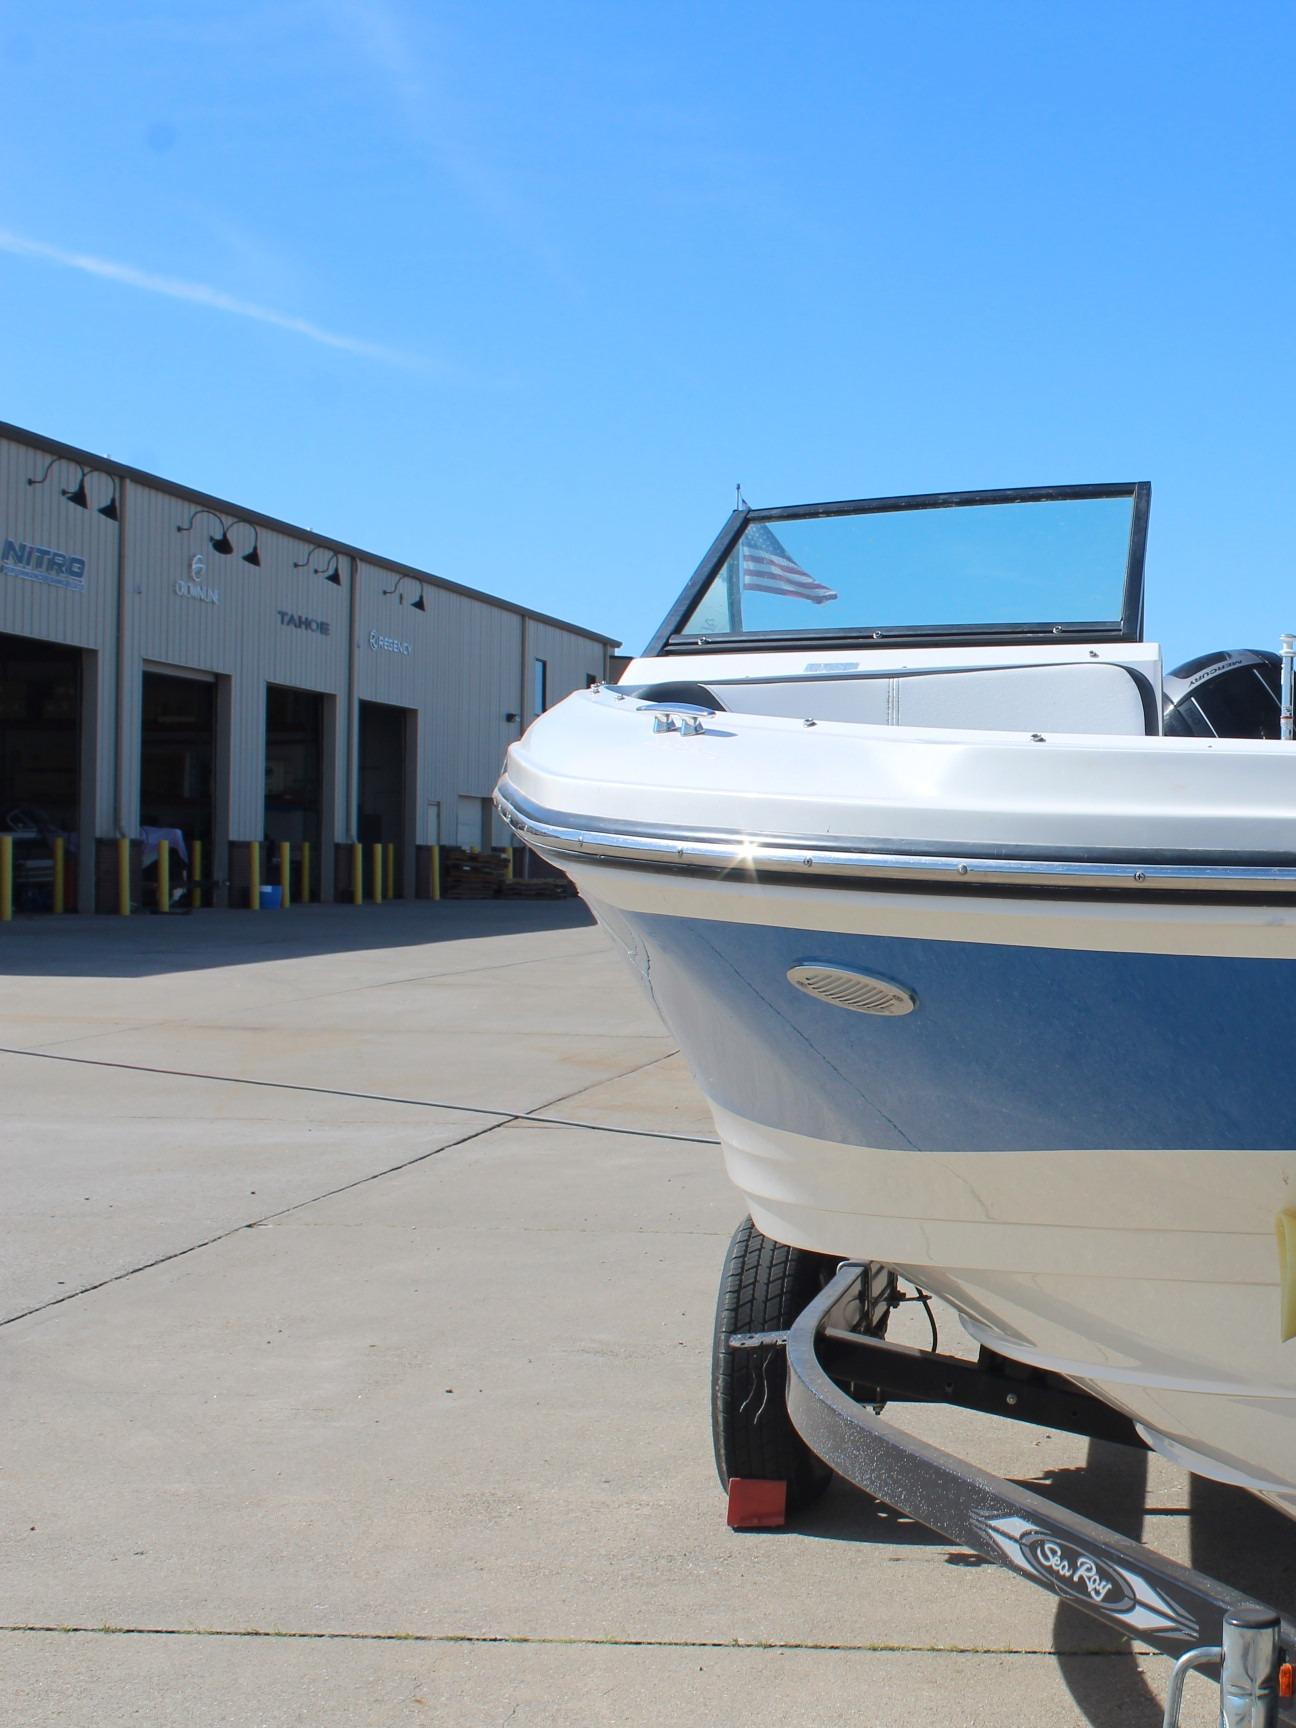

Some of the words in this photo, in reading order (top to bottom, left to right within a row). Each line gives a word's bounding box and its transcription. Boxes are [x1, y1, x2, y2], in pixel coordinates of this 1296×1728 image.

[1, 537, 86, 578] NITRO
[278, 610, 331, 636] TAHOE
[377, 635, 412, 655] REGENCY
[1188, 659, 1243, 688] MERCURY
[1036, 1543, 1073, 1578] Sea
[1073, 1557, 1113, 1602] Ray
